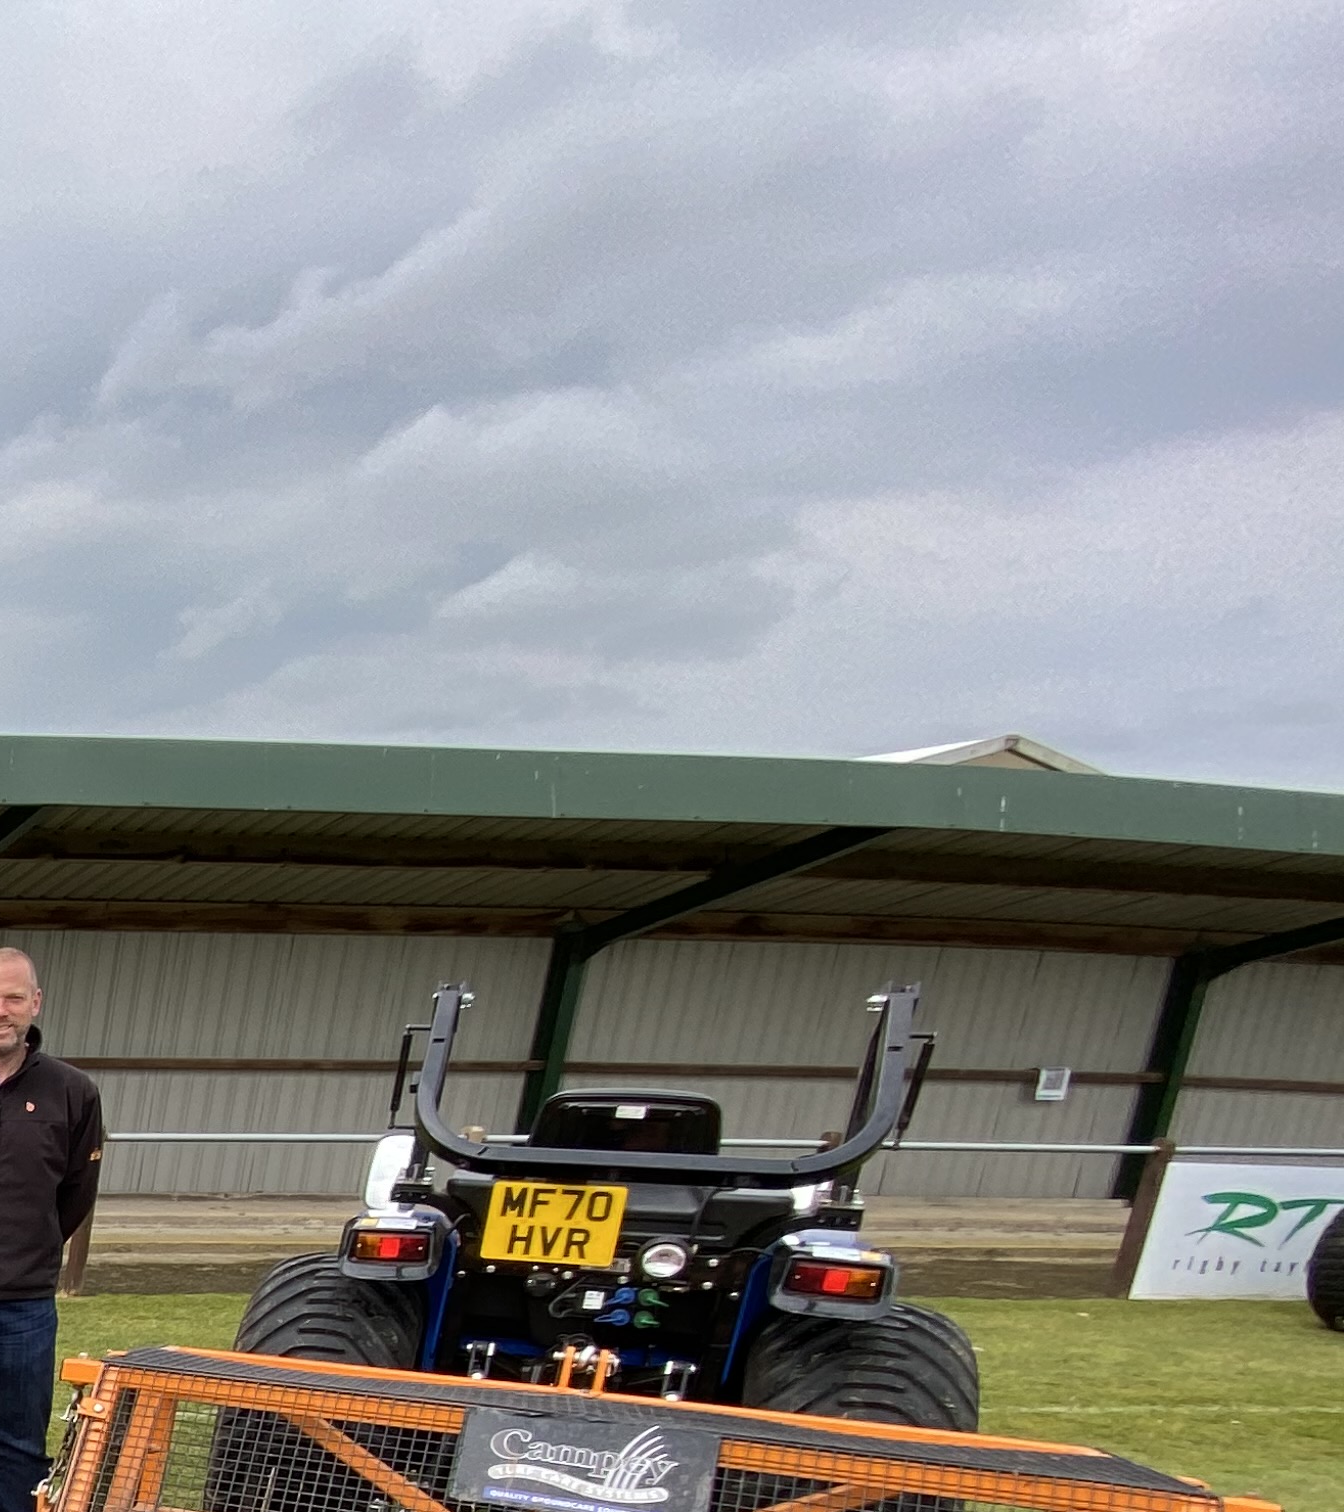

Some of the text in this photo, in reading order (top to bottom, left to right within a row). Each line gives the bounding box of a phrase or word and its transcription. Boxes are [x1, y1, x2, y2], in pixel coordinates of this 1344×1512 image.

[500, 1186, 614, 1223] MF70
[507, 1224, 591, 1260] HVR
[1172, 1255, 1242, 1275] rigby
[489, 1489, 530, 1502] QUALITY
